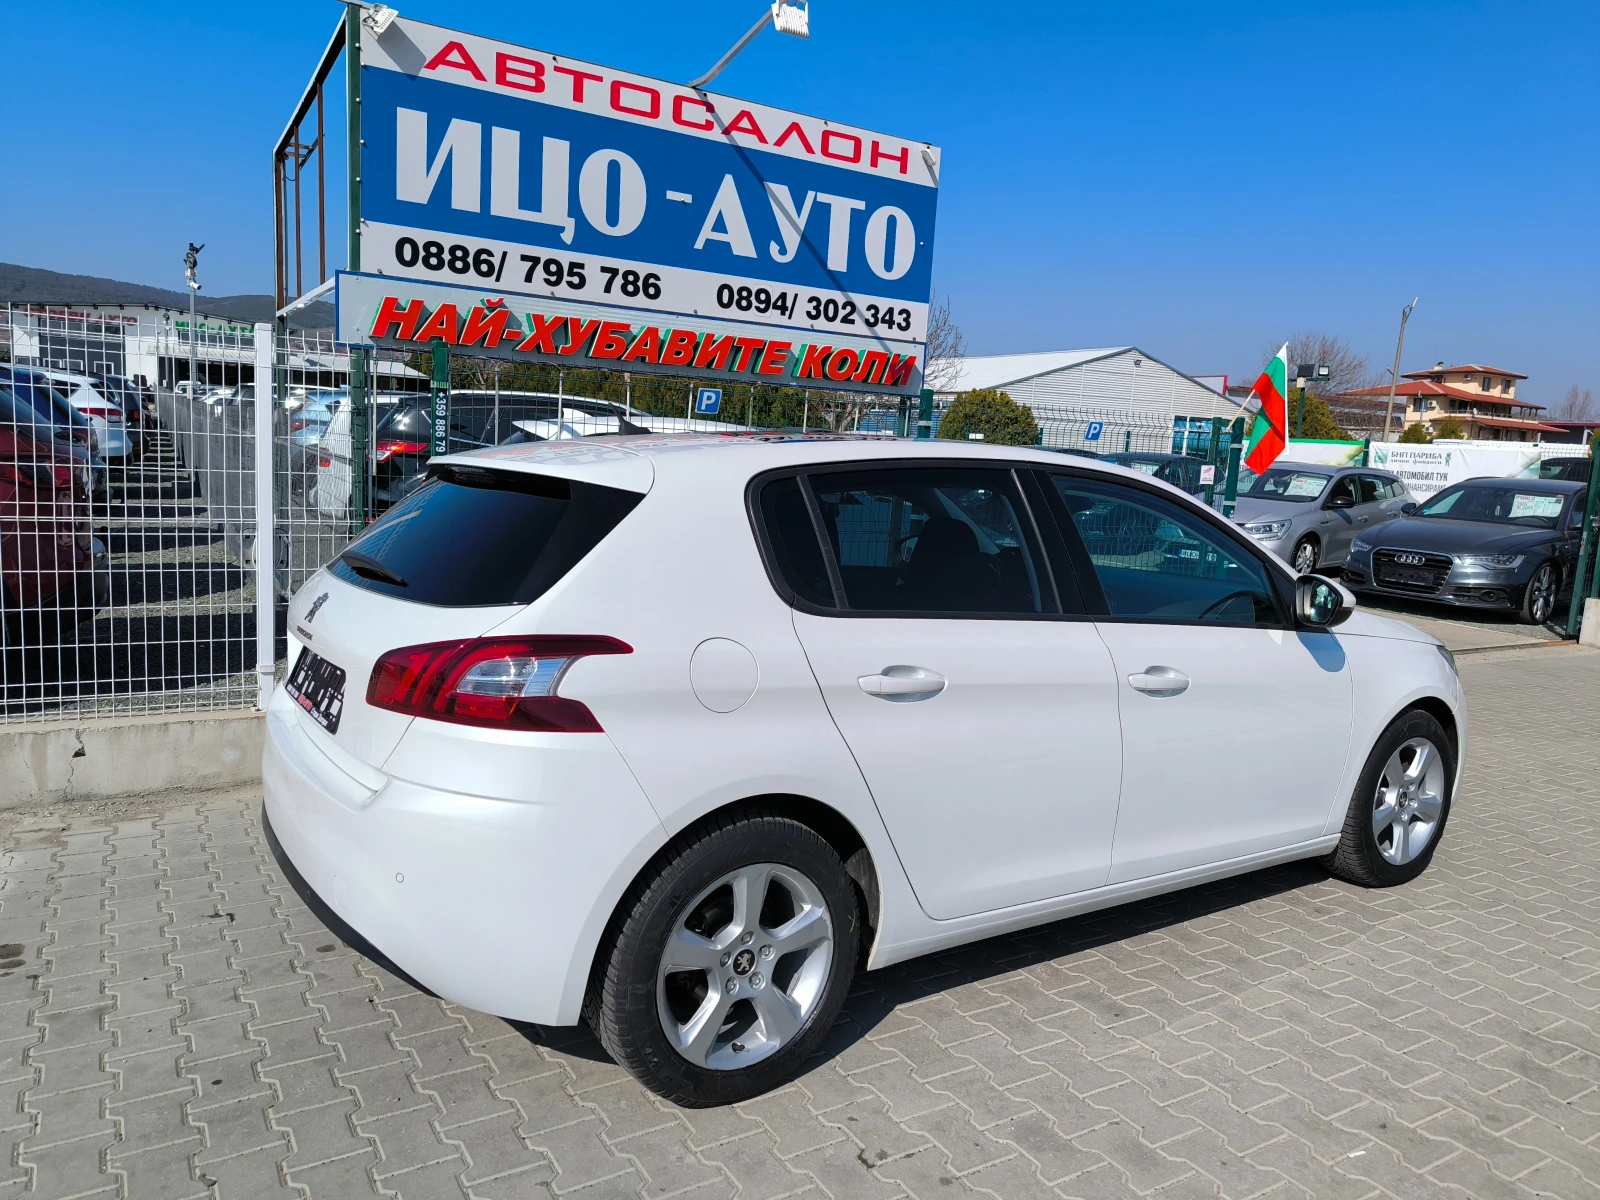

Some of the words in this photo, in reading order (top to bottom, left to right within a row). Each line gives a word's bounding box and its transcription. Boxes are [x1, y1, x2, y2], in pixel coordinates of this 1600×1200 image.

[424, 40, 909, 175] АВТОСАЛОН
[395, 236, 508, 284] 0886/
[520, 254, 588, 291] 795
[600, 266, 662, 301] 786
[716, 283, 798, 321] 0894/
[805, 295, 858, 323] 302
[865, 304, 912, 332] 343
[370, 296, 793, 376] НАЙ-ХУБАВИТЕ
[800, 344, 918, 387] КОЛИ
[434, 391, 447, 416] +359
[701, 391, 717, 410] P
[435, 419, 446, 437] 886
[1410, 451, 1442, 460] ПАРИБА
[1436, 472, 1448, 482] ТУК
